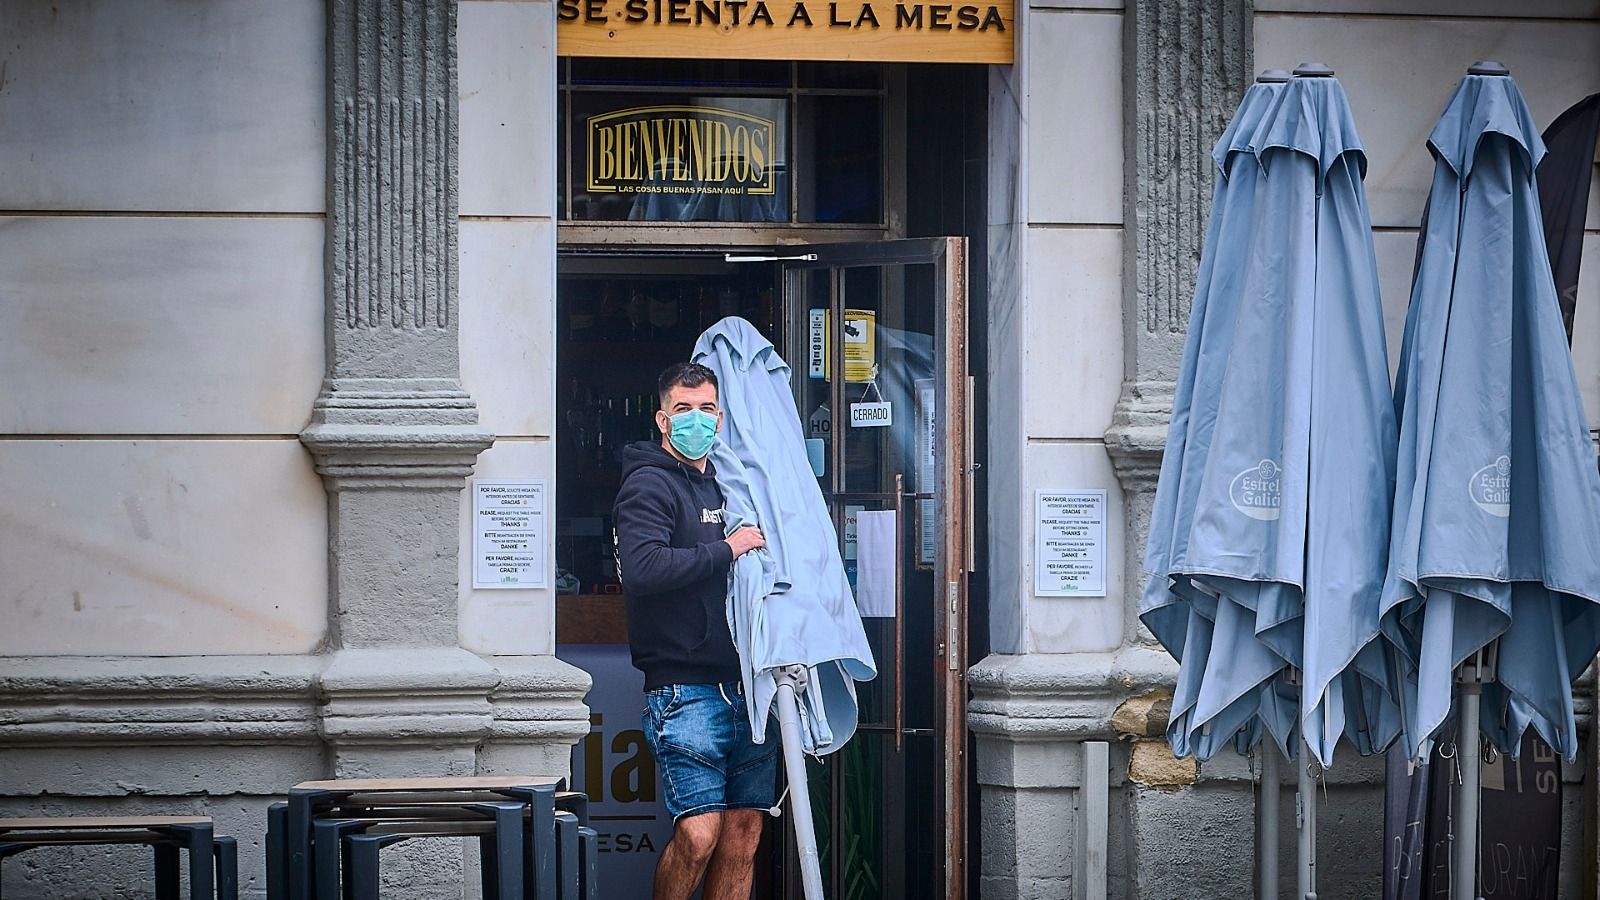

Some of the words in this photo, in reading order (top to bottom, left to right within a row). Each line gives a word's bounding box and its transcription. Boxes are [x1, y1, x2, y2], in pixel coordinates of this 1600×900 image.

[557, 0, 608, 23] SE
[625, 0, 774, 26] SIENTA
[787, 2, 813, 26] A
[829, 2, 880, 27] LA
[896, 4, 1006, 31] MESA
[598, 118, 765, 184] BIENVENIDOS
[636, 186, 662, 194] COSAS
[854, 408, 888, 421] CERRADO
[1242, 476, 1280, 492] Estrel
[1242, 491, 1280, 506] Galici
[1483, 488, 1510, 502] Gali
[598, 833, 656, 852] ESA
